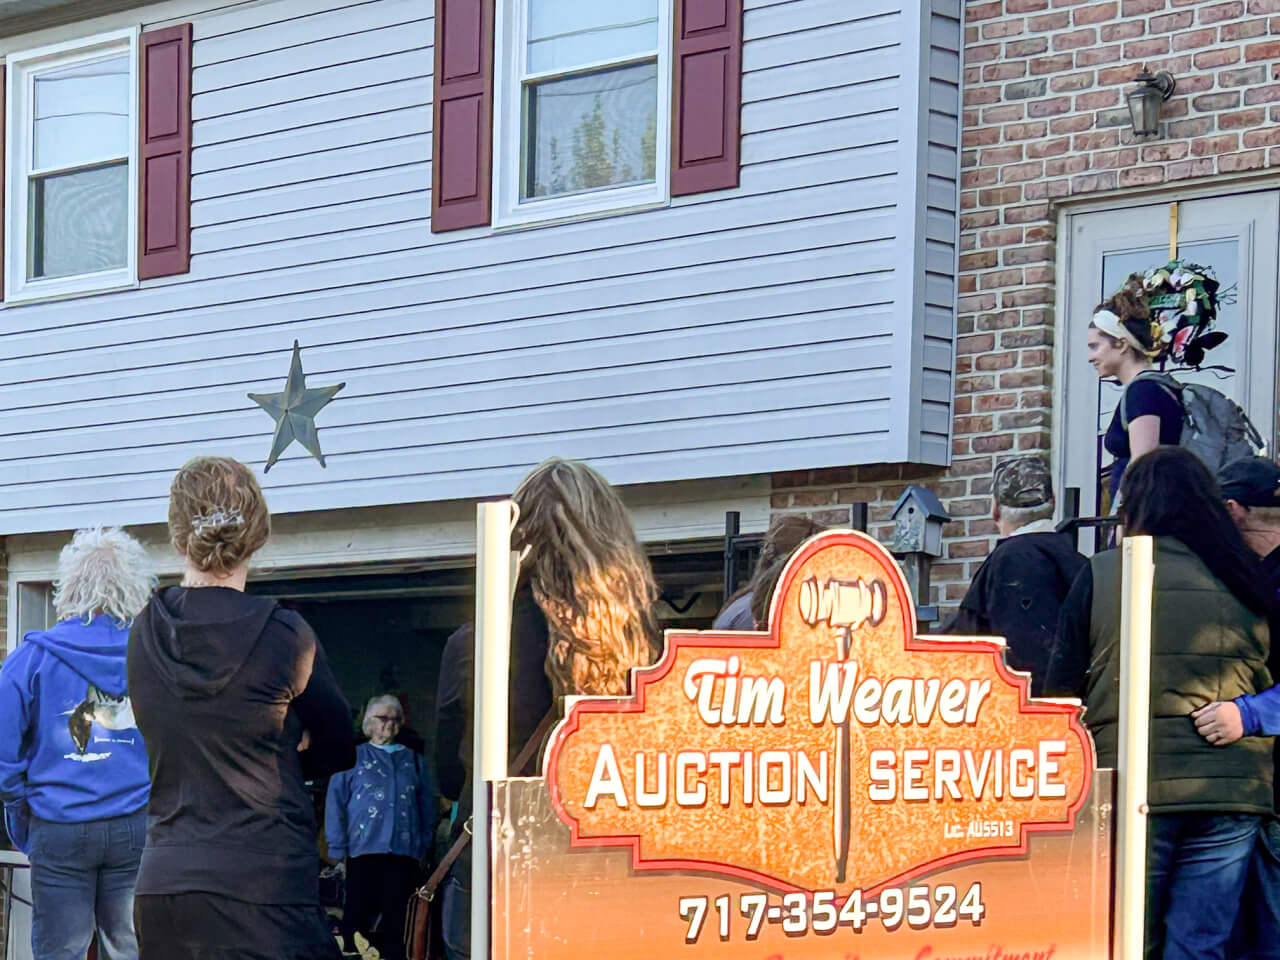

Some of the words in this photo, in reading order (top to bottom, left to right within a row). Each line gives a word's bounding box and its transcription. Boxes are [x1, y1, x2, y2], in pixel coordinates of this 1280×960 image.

[684, 656, 785, 725] Tim
[810, 660, 990, 726] Weaver
[584, 743, 829, 808] AUCTION
[869, 740, 1066, 802] SERVICE
[679, 883, 985, 943] 717-354-9524
